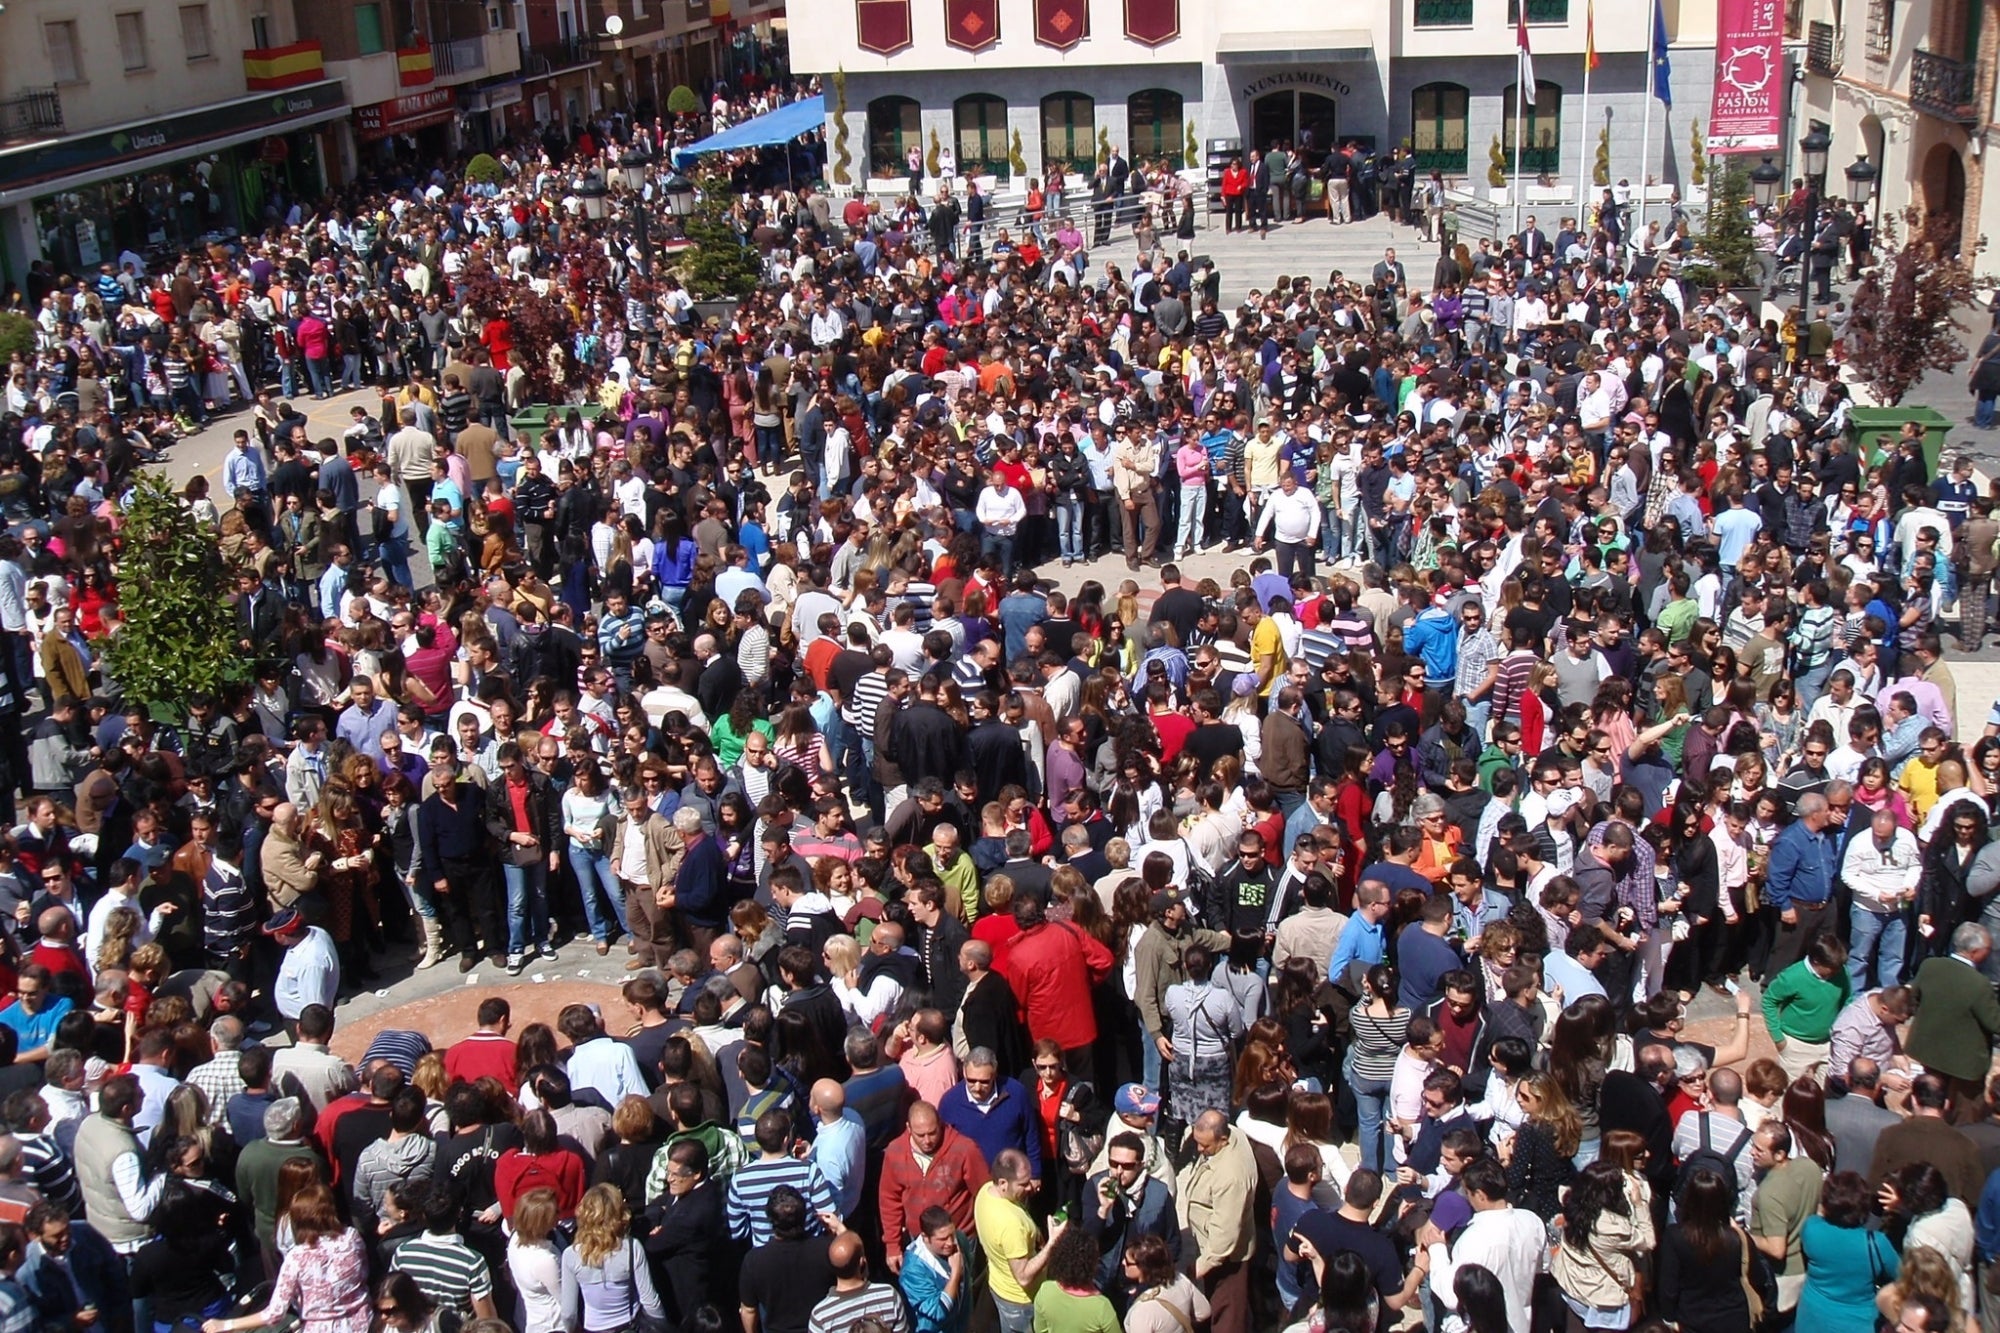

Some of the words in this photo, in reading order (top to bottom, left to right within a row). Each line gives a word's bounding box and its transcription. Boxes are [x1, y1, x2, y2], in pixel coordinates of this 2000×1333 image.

[1759, 2, 1775, 30] Las
[1242, 71, 1351, 99] AYUNTAMIENTO
[286, 98, 313, 114] Unicaja
[397, 95, 421, 112] PLAZA
[423, 89, 449, 106] MAYOR
[1717, 107, 1769, 116] CALATRAVA
[362, 120, 381, 129] BAR
[131, 131, 167, 150] Unicaja
[450, 1153, 471, 1177] JOGO
